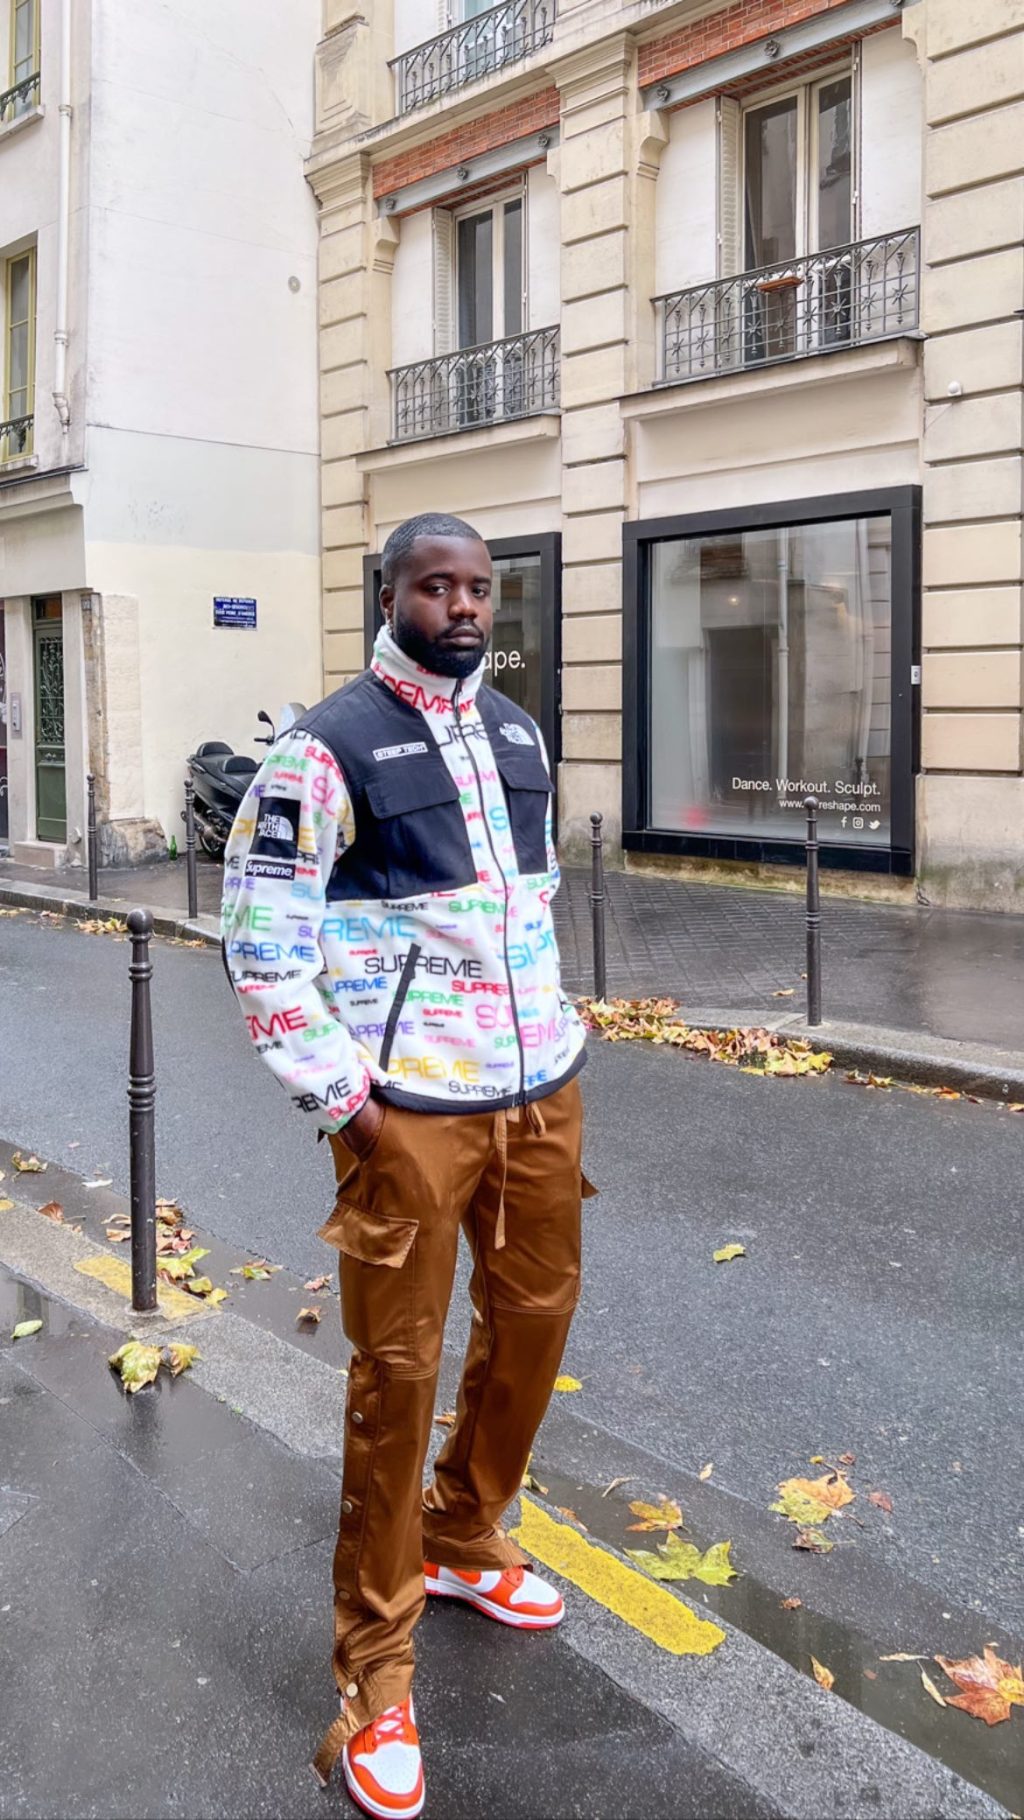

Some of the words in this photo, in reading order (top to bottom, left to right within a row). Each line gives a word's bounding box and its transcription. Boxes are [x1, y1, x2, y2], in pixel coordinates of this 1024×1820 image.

[732, 777, 772, 791] Dance.
[776, 778, 831, 793] Workout.
[835, 780, 881, 798] Sculpt.
[247, 861, 293, 876] Supreme
[364, 954, 483, 979] SUPREME
